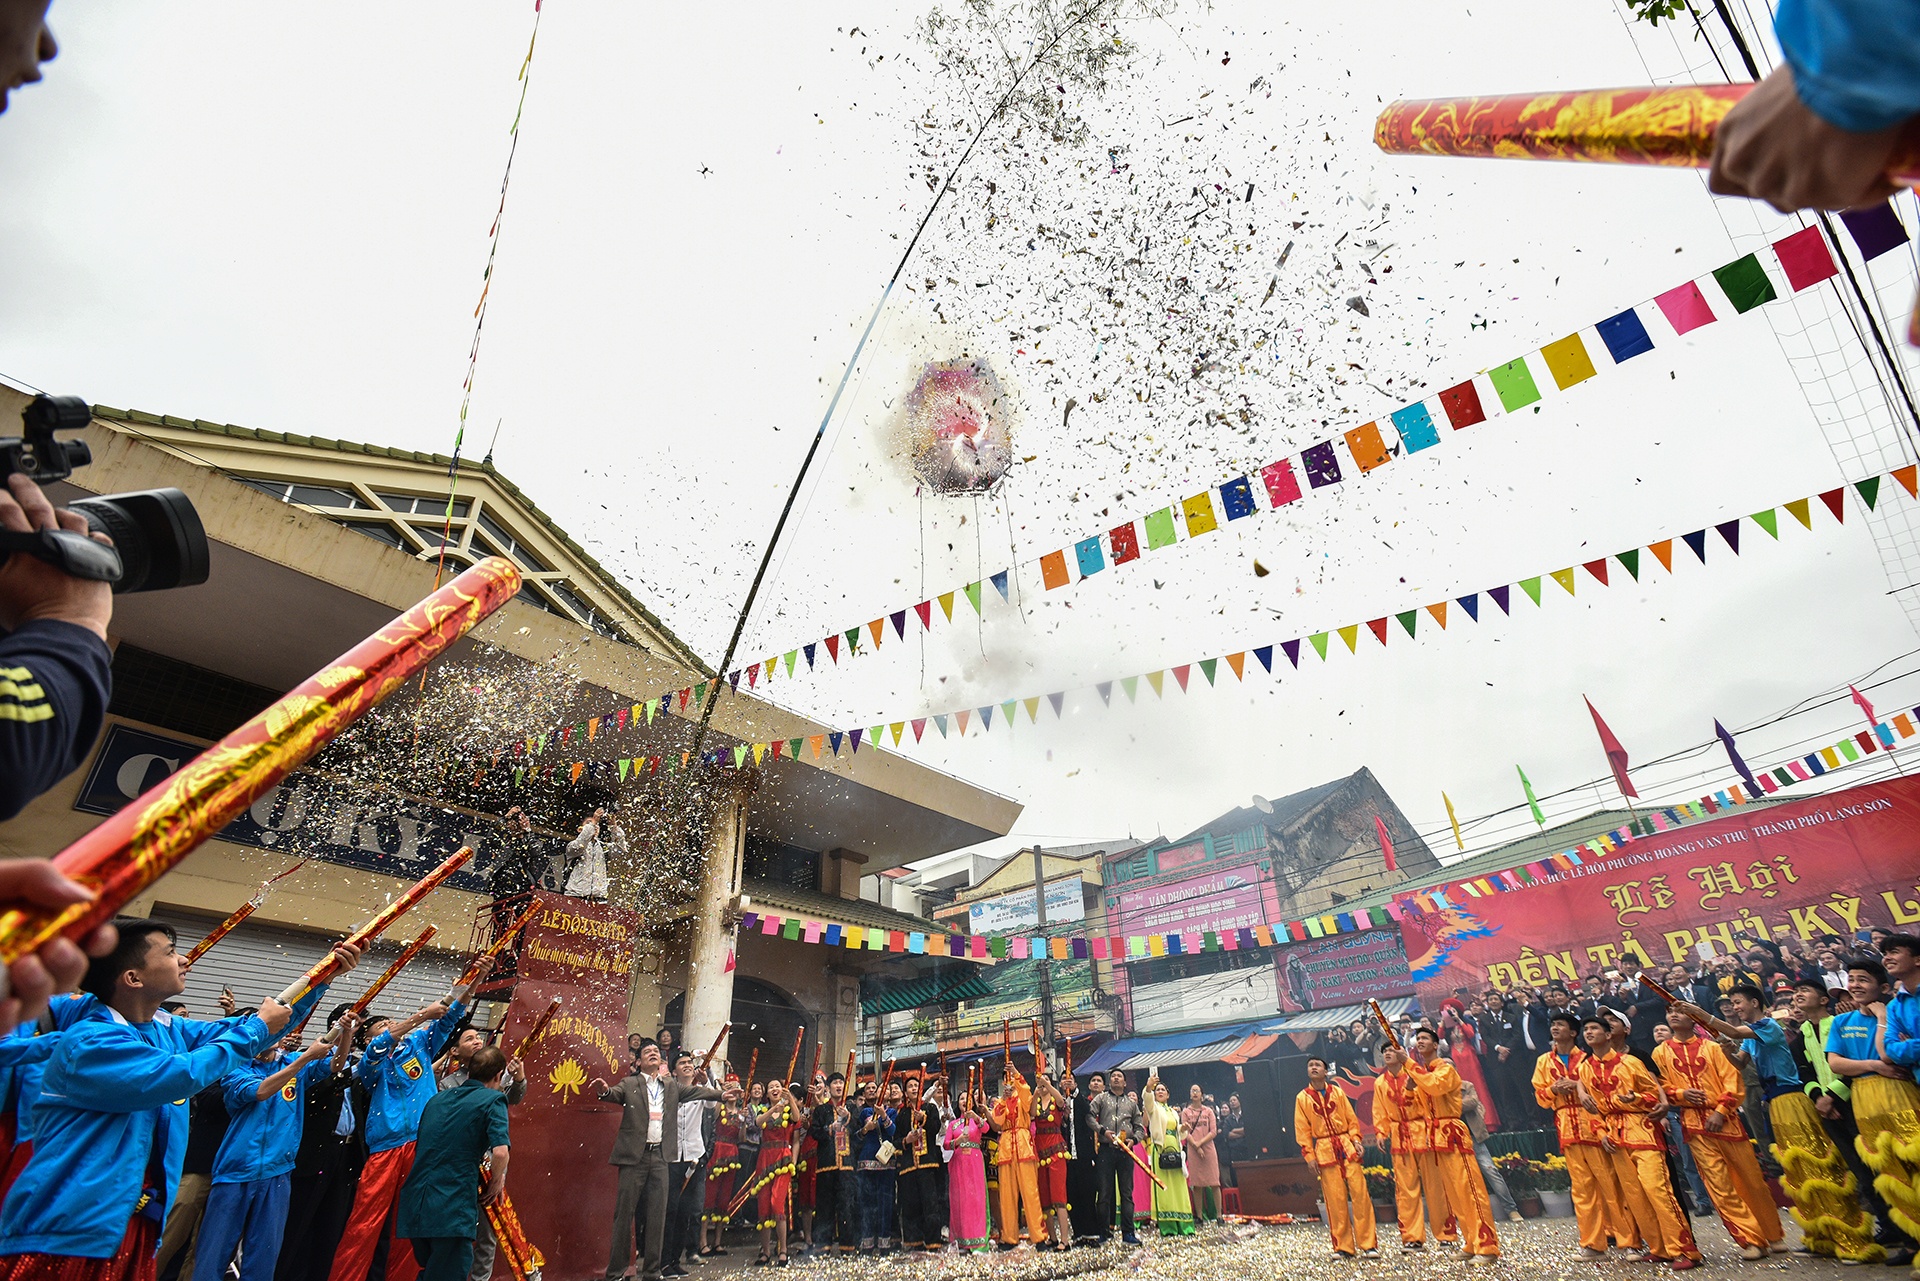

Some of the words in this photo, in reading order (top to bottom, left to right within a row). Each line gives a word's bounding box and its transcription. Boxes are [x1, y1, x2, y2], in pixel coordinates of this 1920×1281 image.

[1585, 861, 1607, 875] HỘI
[1607, 851, 1654, 870] PHƯỜNG
[1654, 842, 1697, 860] HOÀNG
[1696, 836, 1723, 850] VĂN
[1722, 829, 1749, 843] THỤ
[1751, 818, 1797, 838] THÀNH
[1798, 808, 1826, 829] PHỐ
[1826, 804, 1864, 822] LẠNG
[1864, 797, 1894, 814] SƠN
[1148, 893, 1167, 909] VĂN
[1602, 874, 1676, 927] Lễ
[1686, 855, 1800, 911] Hội
[1308, 939, 1340, 956] LAN
[1486, 945, 1580, 992] ĐỀN
[1586, 930, 1656, 970] TẢ
[1346, 968, 1379, 984] VESTON
